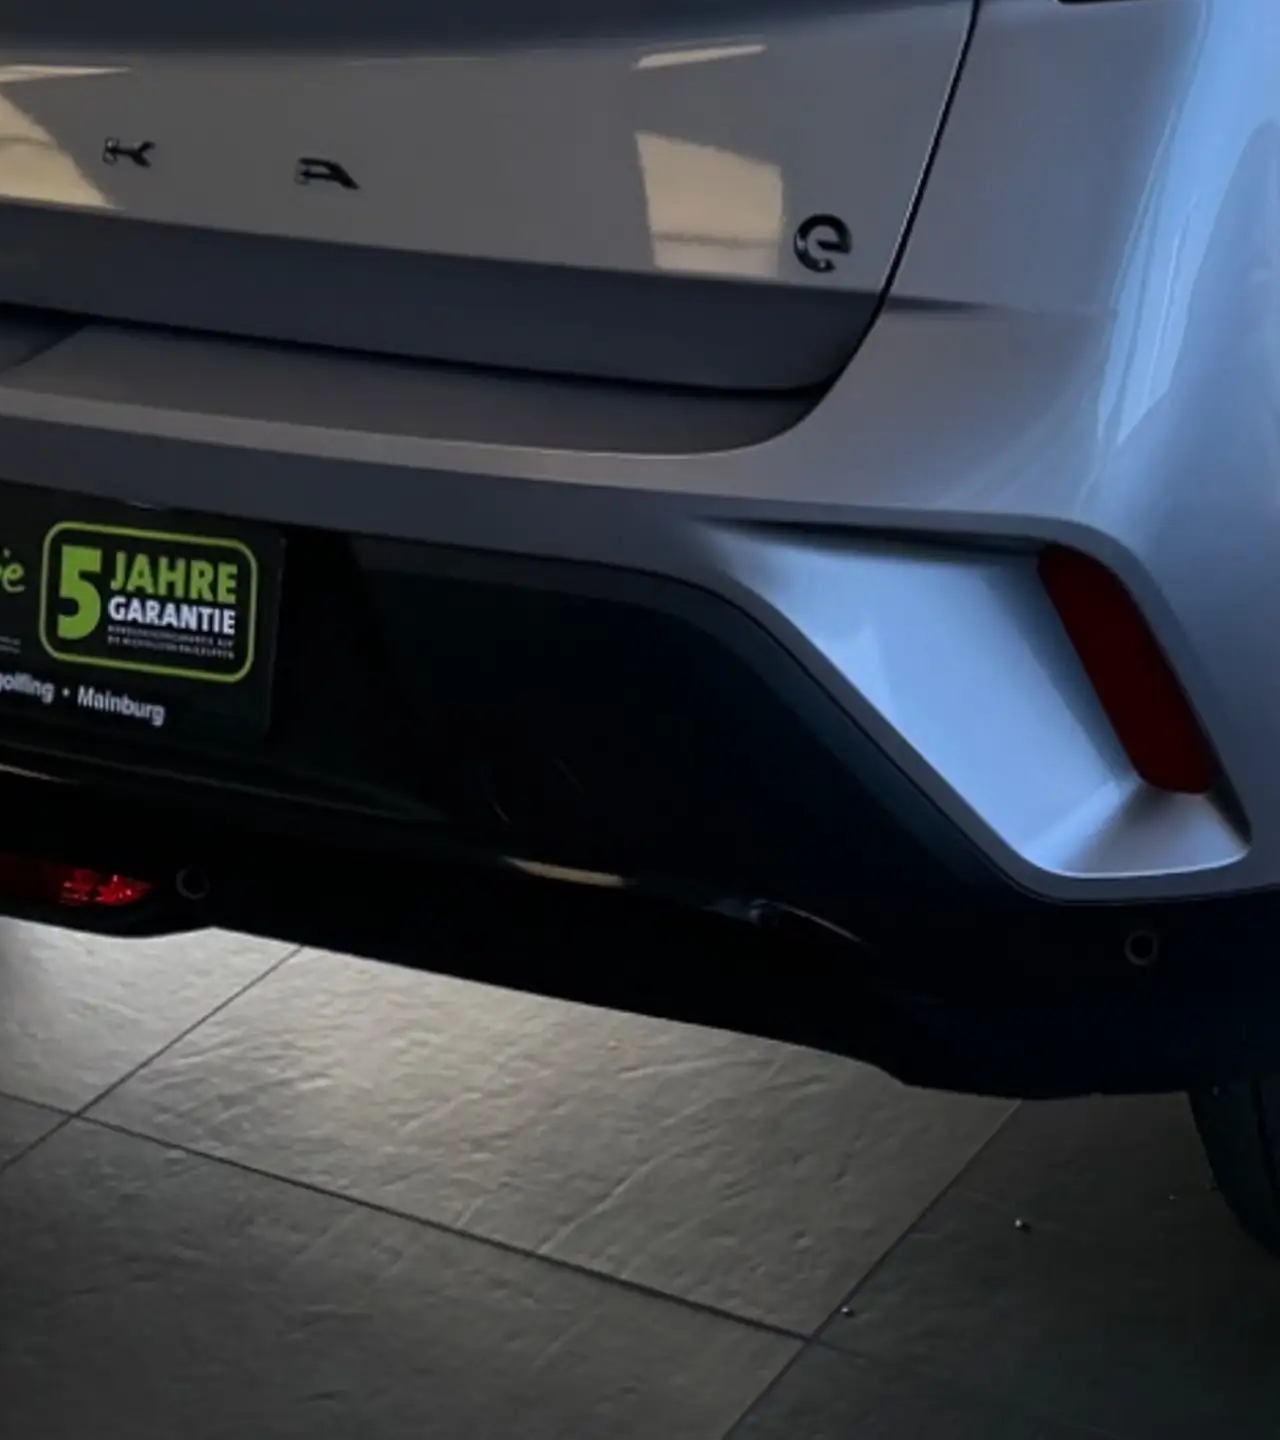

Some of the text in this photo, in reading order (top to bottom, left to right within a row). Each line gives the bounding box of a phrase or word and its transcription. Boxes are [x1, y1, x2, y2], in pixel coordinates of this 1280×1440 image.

[57, 544, 102, 641] 5
[109, 550, 238, 606] JAHRE
[108, 597, 237, 636] GARANTIE
[77, 684, 167, 728] Mainburg
